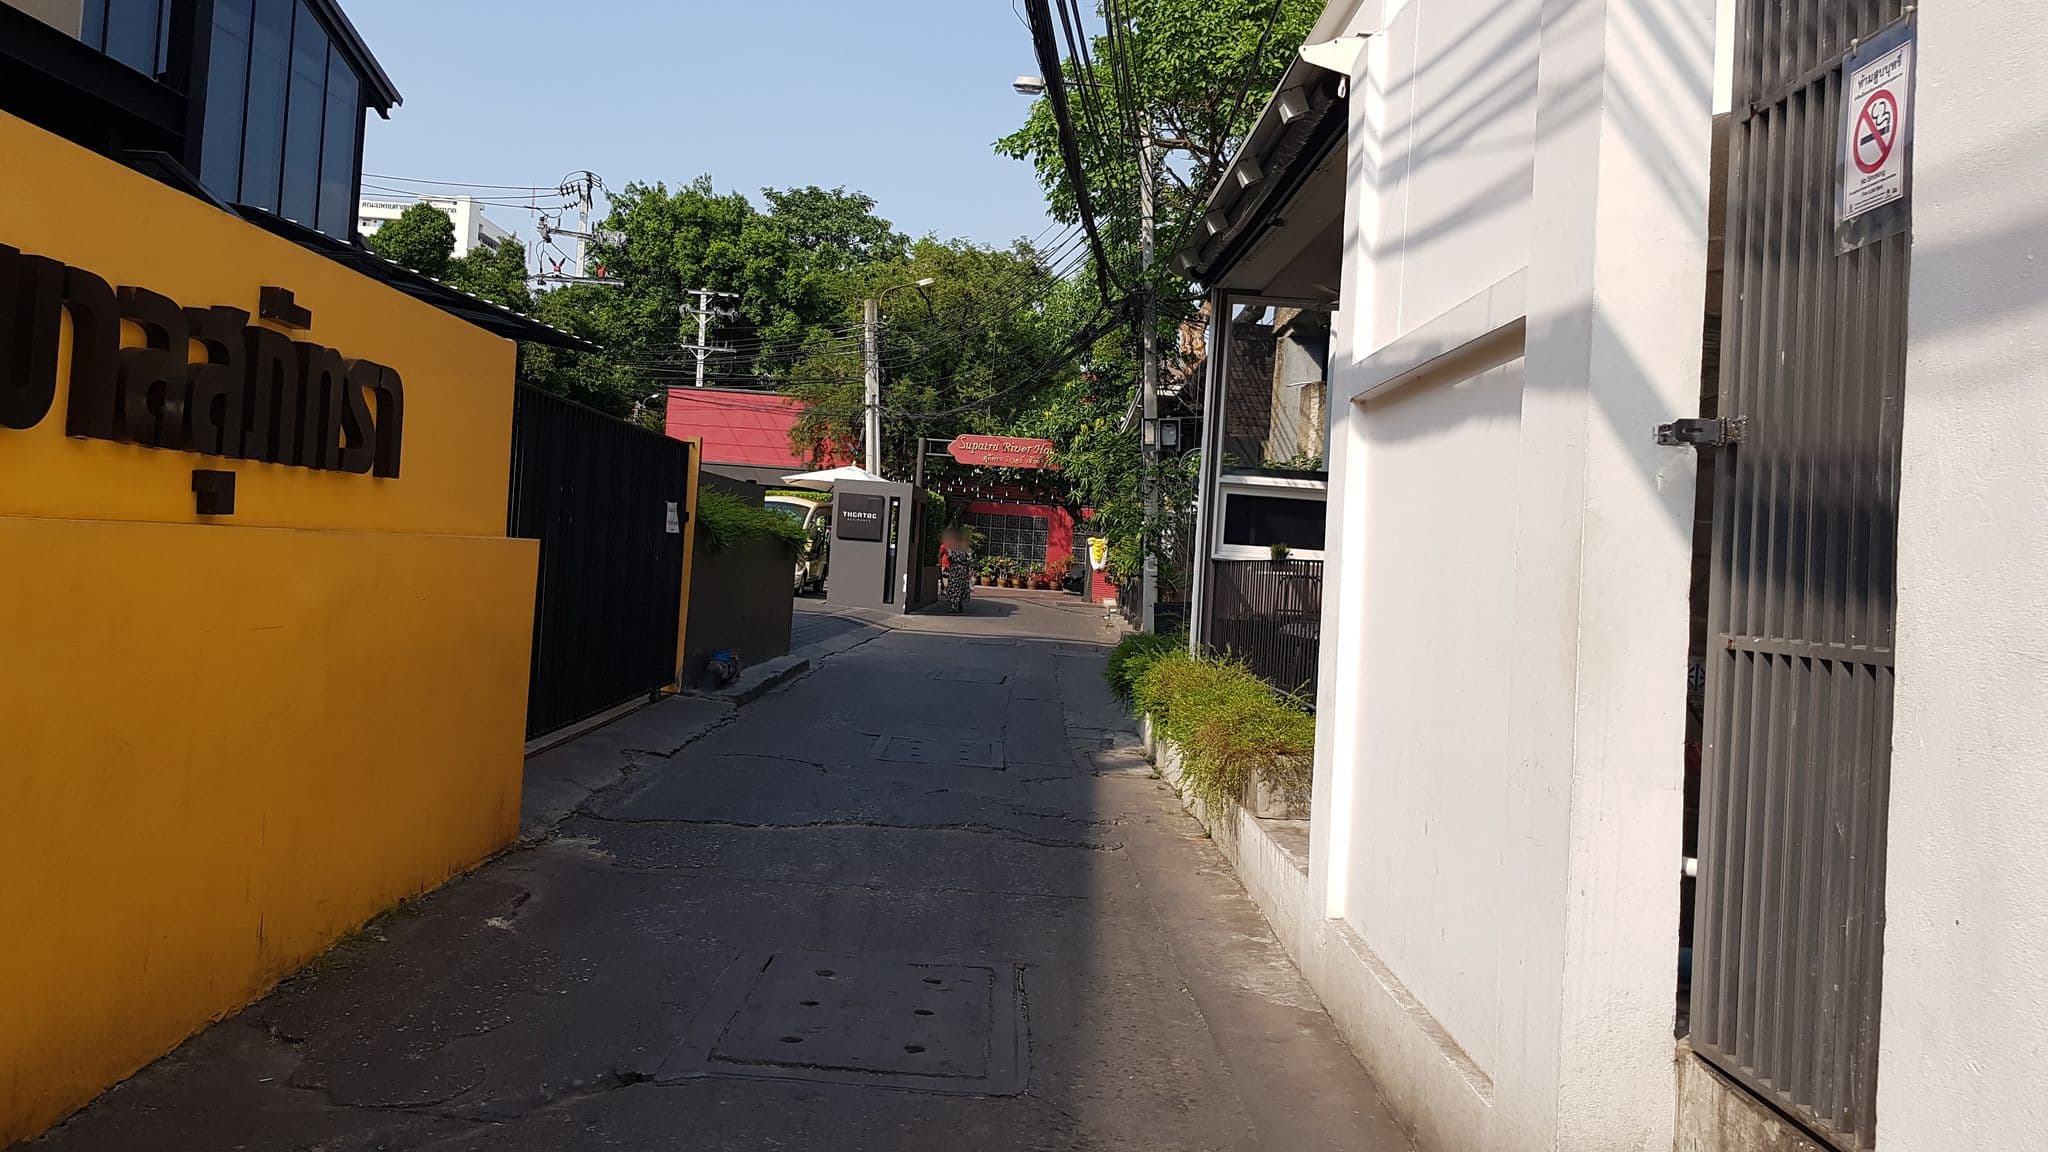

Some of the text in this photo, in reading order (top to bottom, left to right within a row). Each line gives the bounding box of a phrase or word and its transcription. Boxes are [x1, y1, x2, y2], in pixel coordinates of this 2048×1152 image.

[959, 436, 999, 454] Supatra
[1002, 441, 1033, 454] River
[843, 511, 877, 519] THEATRE
